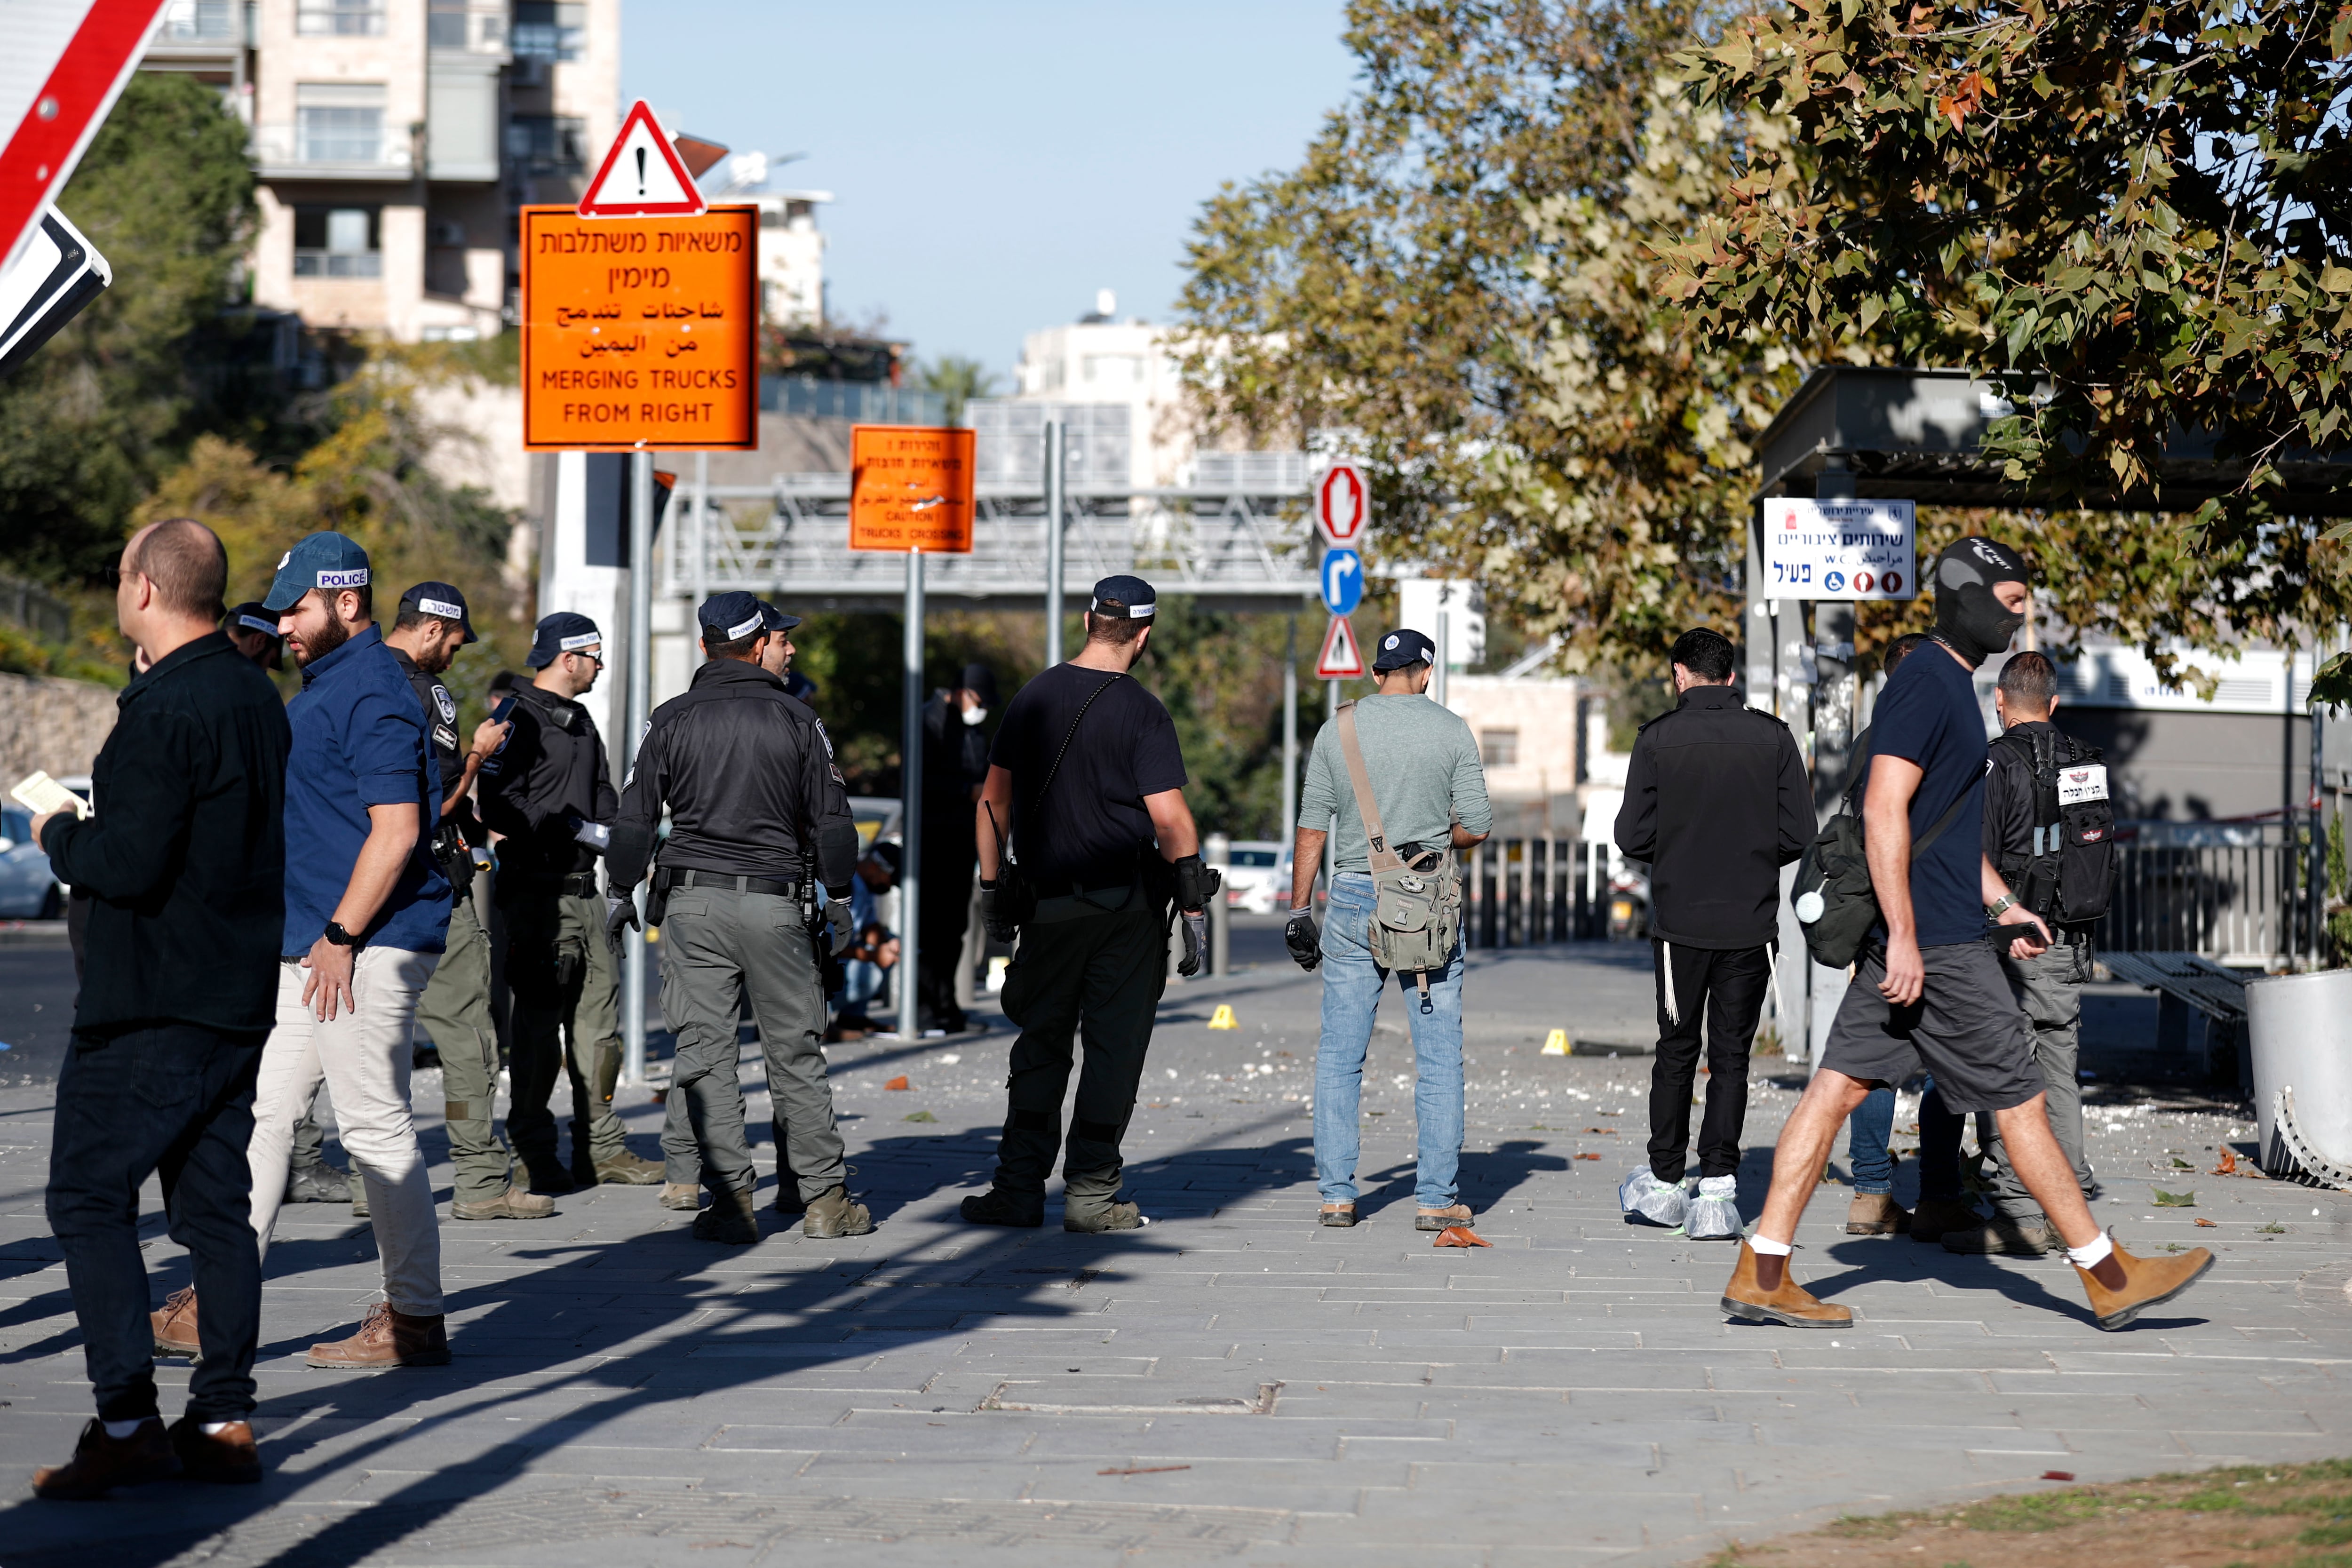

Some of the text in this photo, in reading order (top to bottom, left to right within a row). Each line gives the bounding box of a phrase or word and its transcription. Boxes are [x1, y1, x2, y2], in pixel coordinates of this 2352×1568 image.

[540, 227, 742, 254] משאיות משתלבות
[608, 267, 670, 294] מימין
[642, 302, 724, 318] شاحنات
[580, 335, 697, 358] من اليمين
[542, 369, 737, 390] MERGING TRUCKS
[564, 403, 714, 422] FROM RIGHT
[1778, 533, 1903, 547] שירותים ציבוריים
[1970, 538, 2013, 570] OUTWET
[322, 573, 365, 586] POLICE
[1773, 560, 1811, 583] פעיל
[731, 623, 754, 637] משטרה
[2085, 785, 2100, 797] קצין
